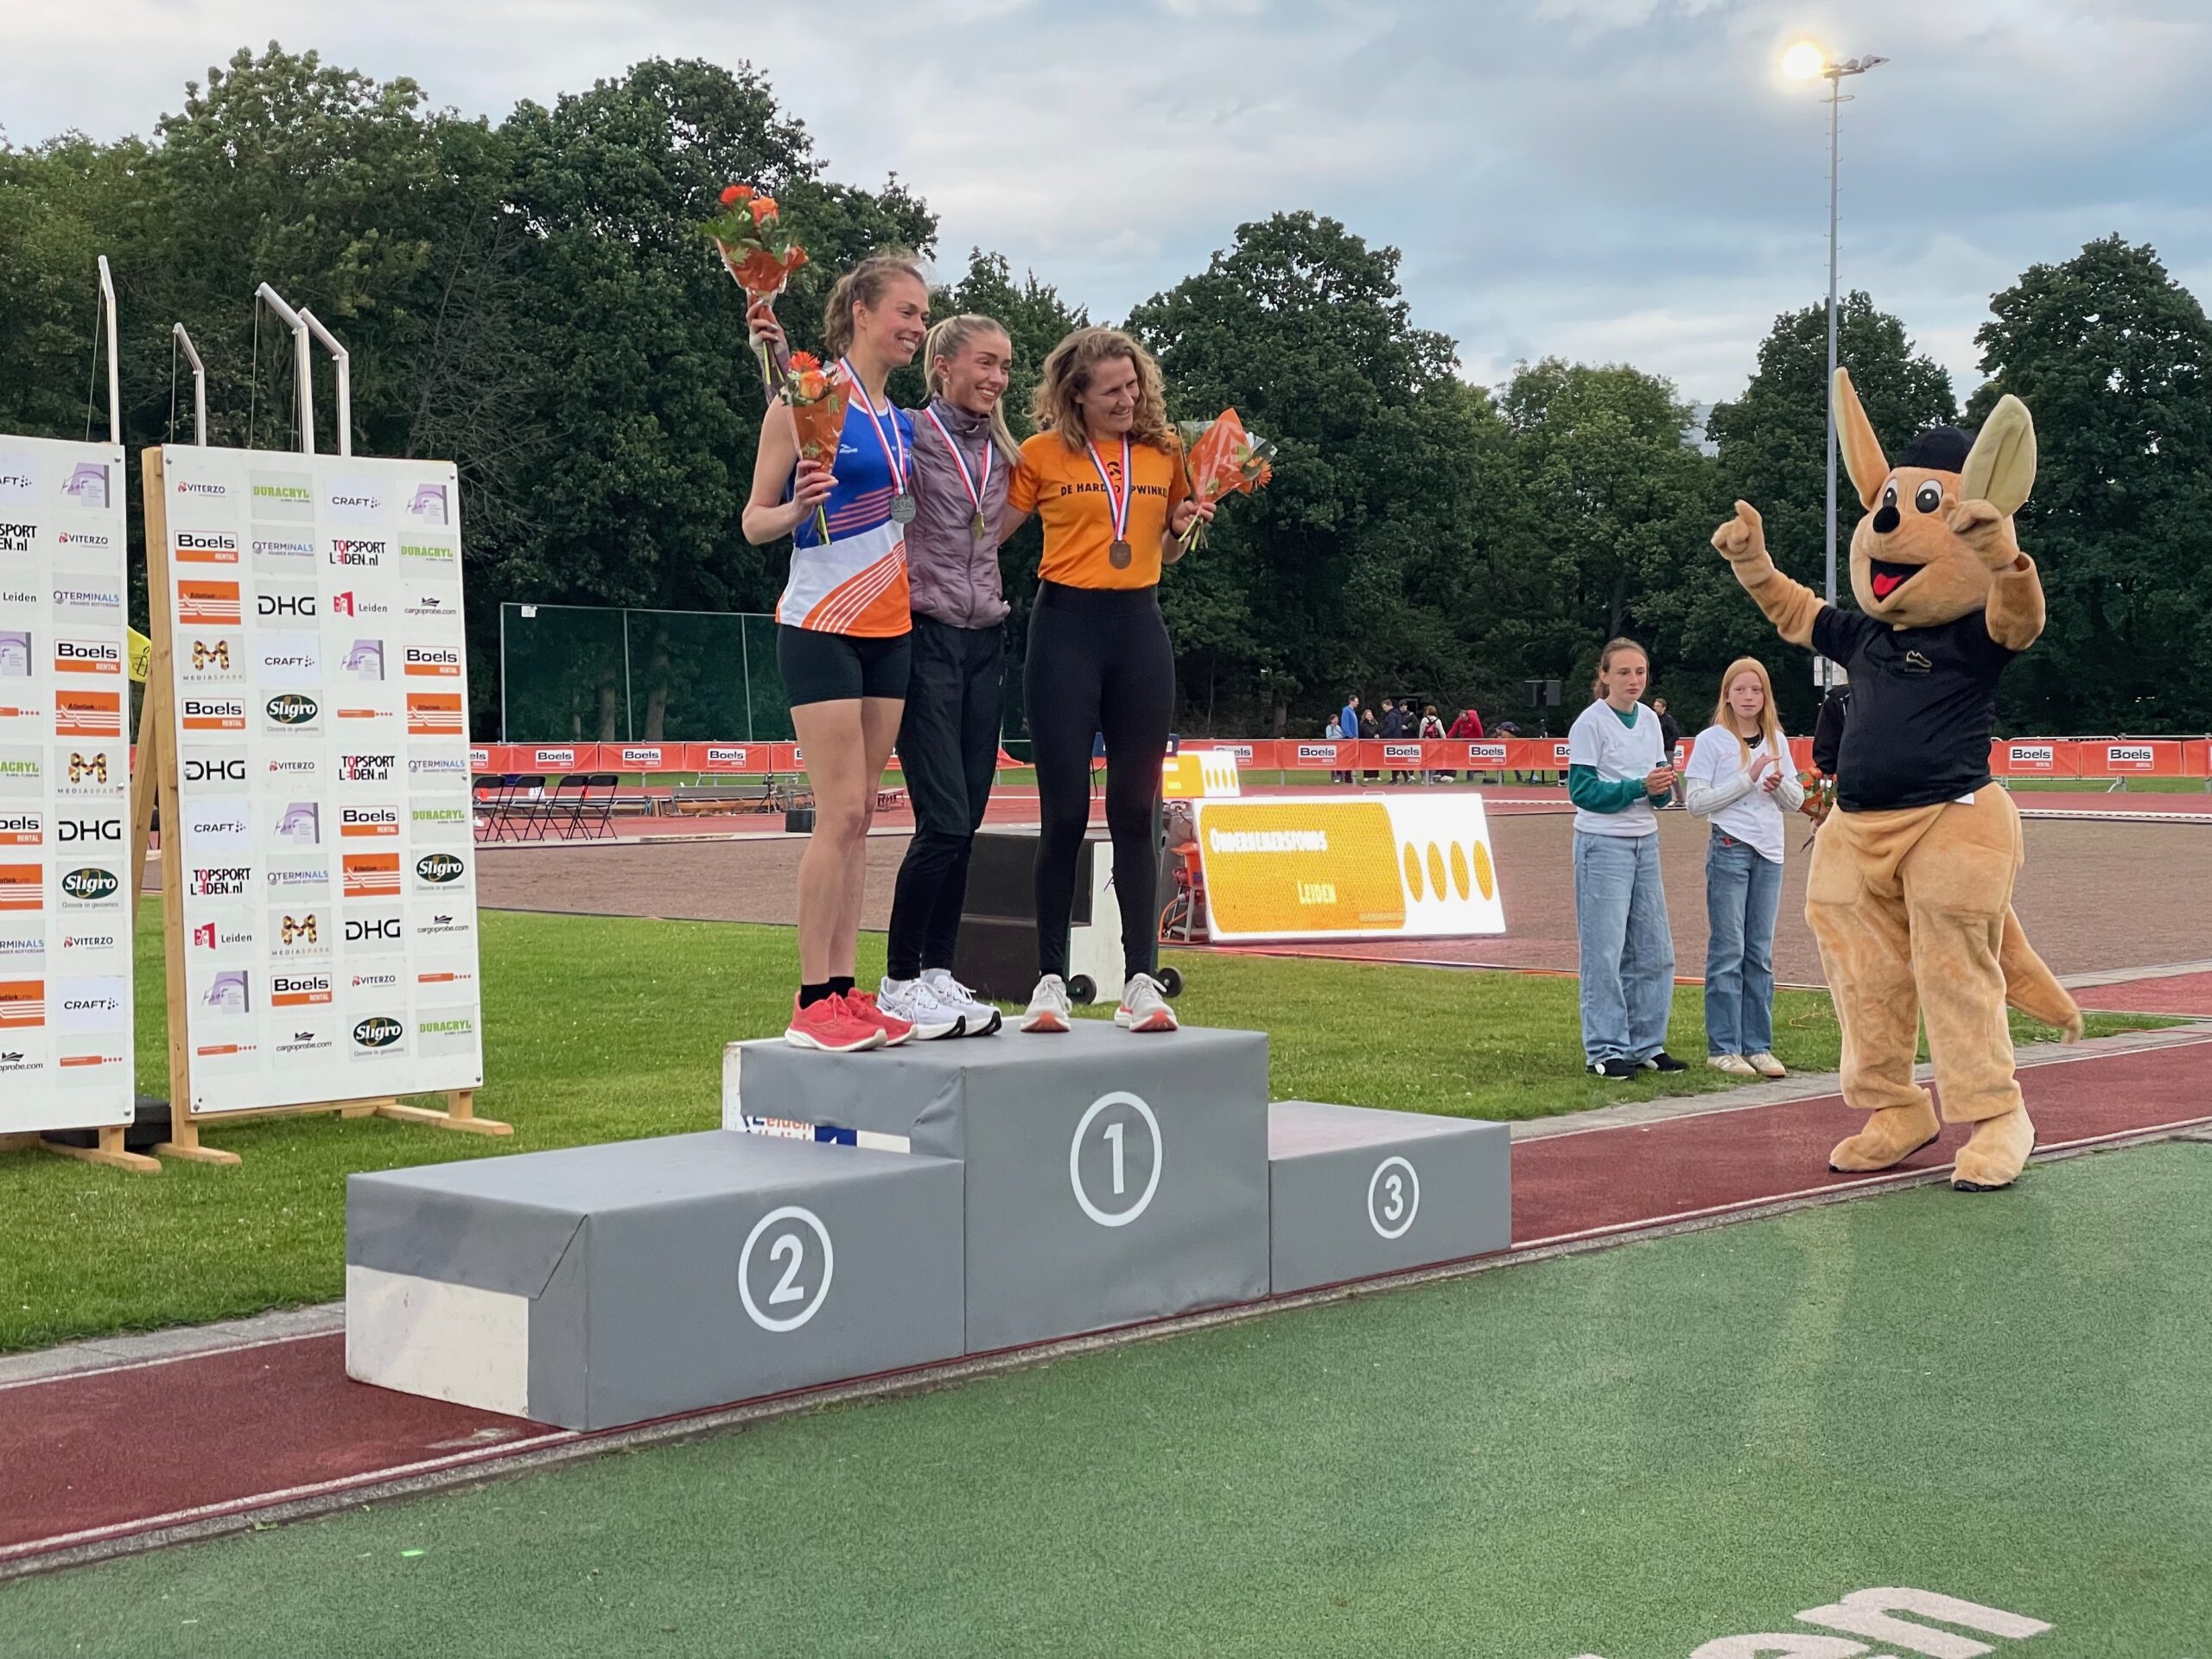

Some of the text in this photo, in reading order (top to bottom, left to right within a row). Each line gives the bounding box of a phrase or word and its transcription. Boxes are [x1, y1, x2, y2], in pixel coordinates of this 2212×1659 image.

[188, 484, 226, 494] VITERZO
[253, 486, 309, 499] DURACRYL
[1061, 485, 1072, 496] DE
[332, 497, 370, 506] CRAFT
[69, 534, 108, 544] VITERZO
[178, 534, 235, 549] Boels
[332, 539, 385, 554] TOPSPORT
[401, 546, 453, 557] DURACRYL
[3, 592, 36, 602] Leiden
[257, 595, 315, 616] DHG
[359, 603, 387, 613] Leiden
[58, 643, 118, 658] Boels
[407, 650, 457, 663] Boels
[185, 702, 242, 715] Boels
[269, 701, 316, 717] Sligro
[537, 752, 572, 760] Boels
[625, 751, 659, 760] Boels
[710, 751, 744, 760] Boels
[1300, 747, 1335, 756] Boels
[2012, 749, 2050, 760] Boels
[2110, 749, 2151, 760] Boels
[278, 761, 315, 770] VITERZO
[341, 755, 395, 768] TOPSPORT
[185, 760, 245, 780] DHG
[343, 810, 396, 823] Boels
[413, 810, 464, 820] DURACRYL
[59, 820, 121, 841] DHG
[194, 823, 234, 832] CRAFT
[419, 861, 461, 876] Sligro
[194, 868, 251, 882] TOPSPORT
[65, 874, 116, 892] Sligro
[346, 918, 401, 940] DHG
[417, 925, 469, 934] cargoprobe.com
[74, 937, 113, 945] VITERZO
[221, 933, 252, 943] Leiden
[274, 977, 329, 991] Boels
[360, 975, 396, 984] VITERZO
[64, 1001, 106, 1009] CRAFT
[356, 1025, 401, 1039] Sligro
[420, 1020, 471, 1033] DURACRYL
[276, 1041, 332, 1052] cargoprobe.com
[1103, 1123, 1124, 1195] 1
[1384, 1173, 1404, 1221] 3
[769, 1234, 804, 1306] 2
